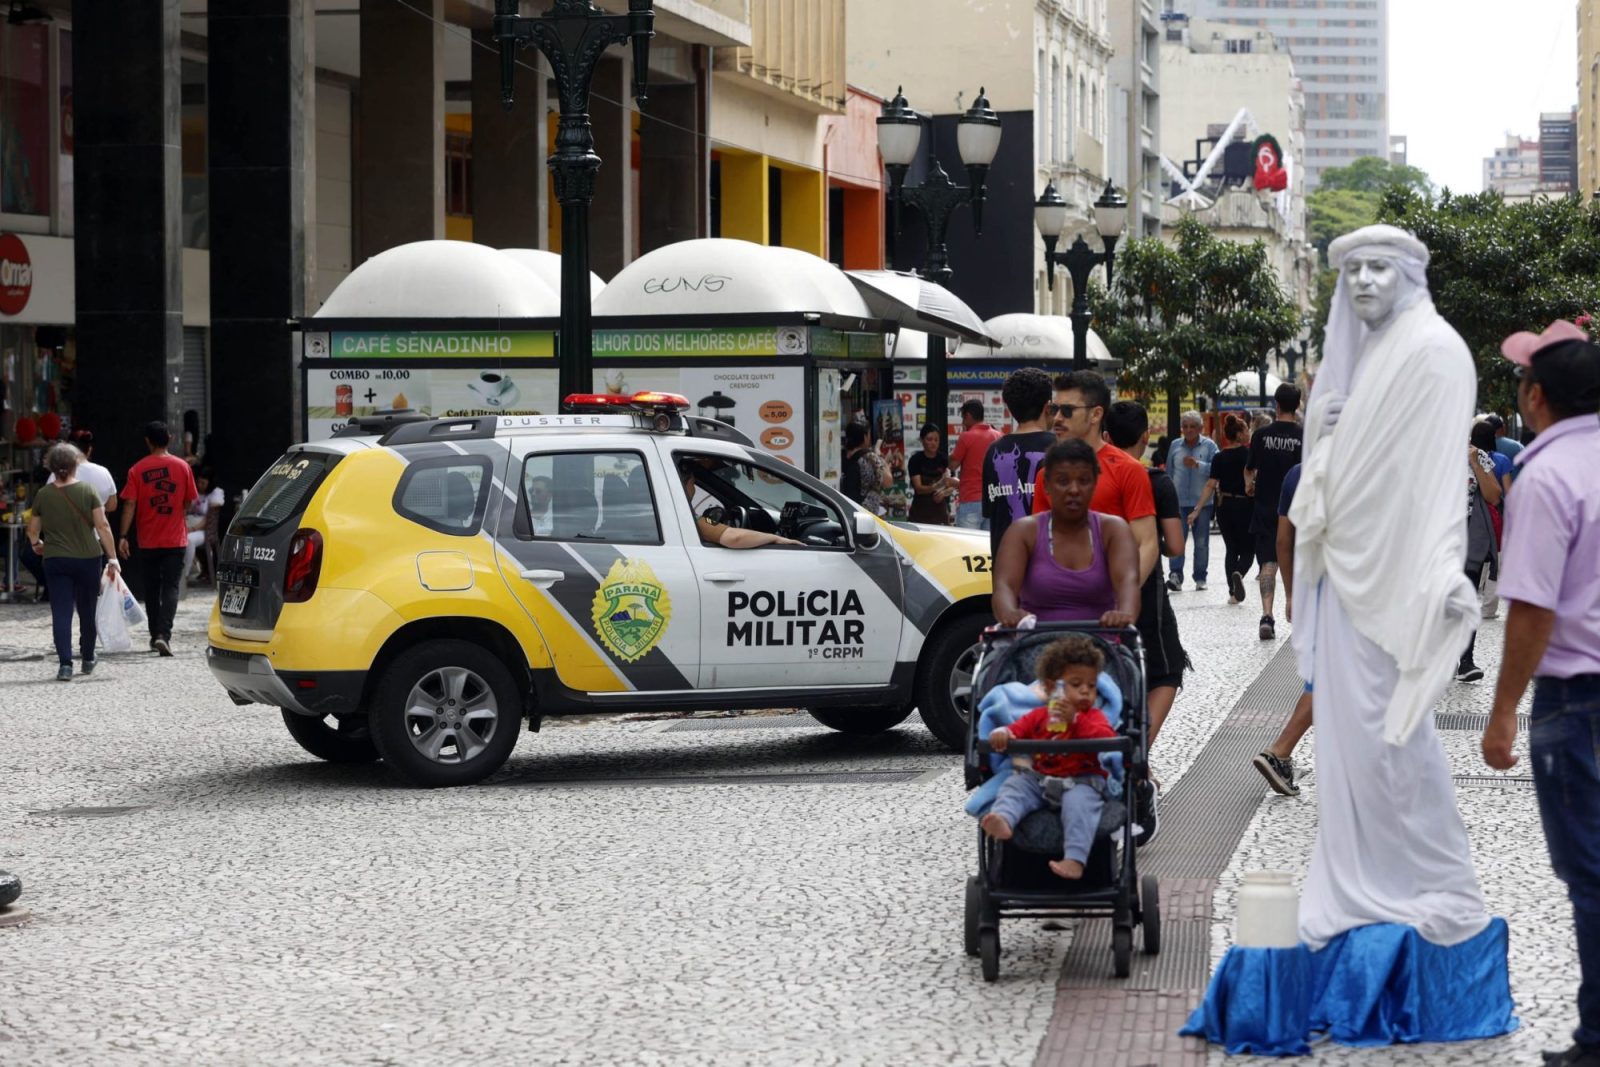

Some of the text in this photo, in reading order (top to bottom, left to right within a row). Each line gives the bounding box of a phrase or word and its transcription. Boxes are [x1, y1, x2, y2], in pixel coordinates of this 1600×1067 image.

[343, 334, 390, 353] CAFÉ
[396, 336, 512, 353] SENADINHO
[592, 335, 631, 351] ELHOR
[634, 335, 660, 351] DOS
[664, 333, 735, 351] MELHORES
[330, 370, 370, 380] COMBO
[946, 371, 976, 379] BANCA
[503, 417, 601, 426] DUSTER
[253, 547, 275, 561] 12322
[727, 620, 864, 646] MILITAR
[823, 647, 863, 658] CRPM
